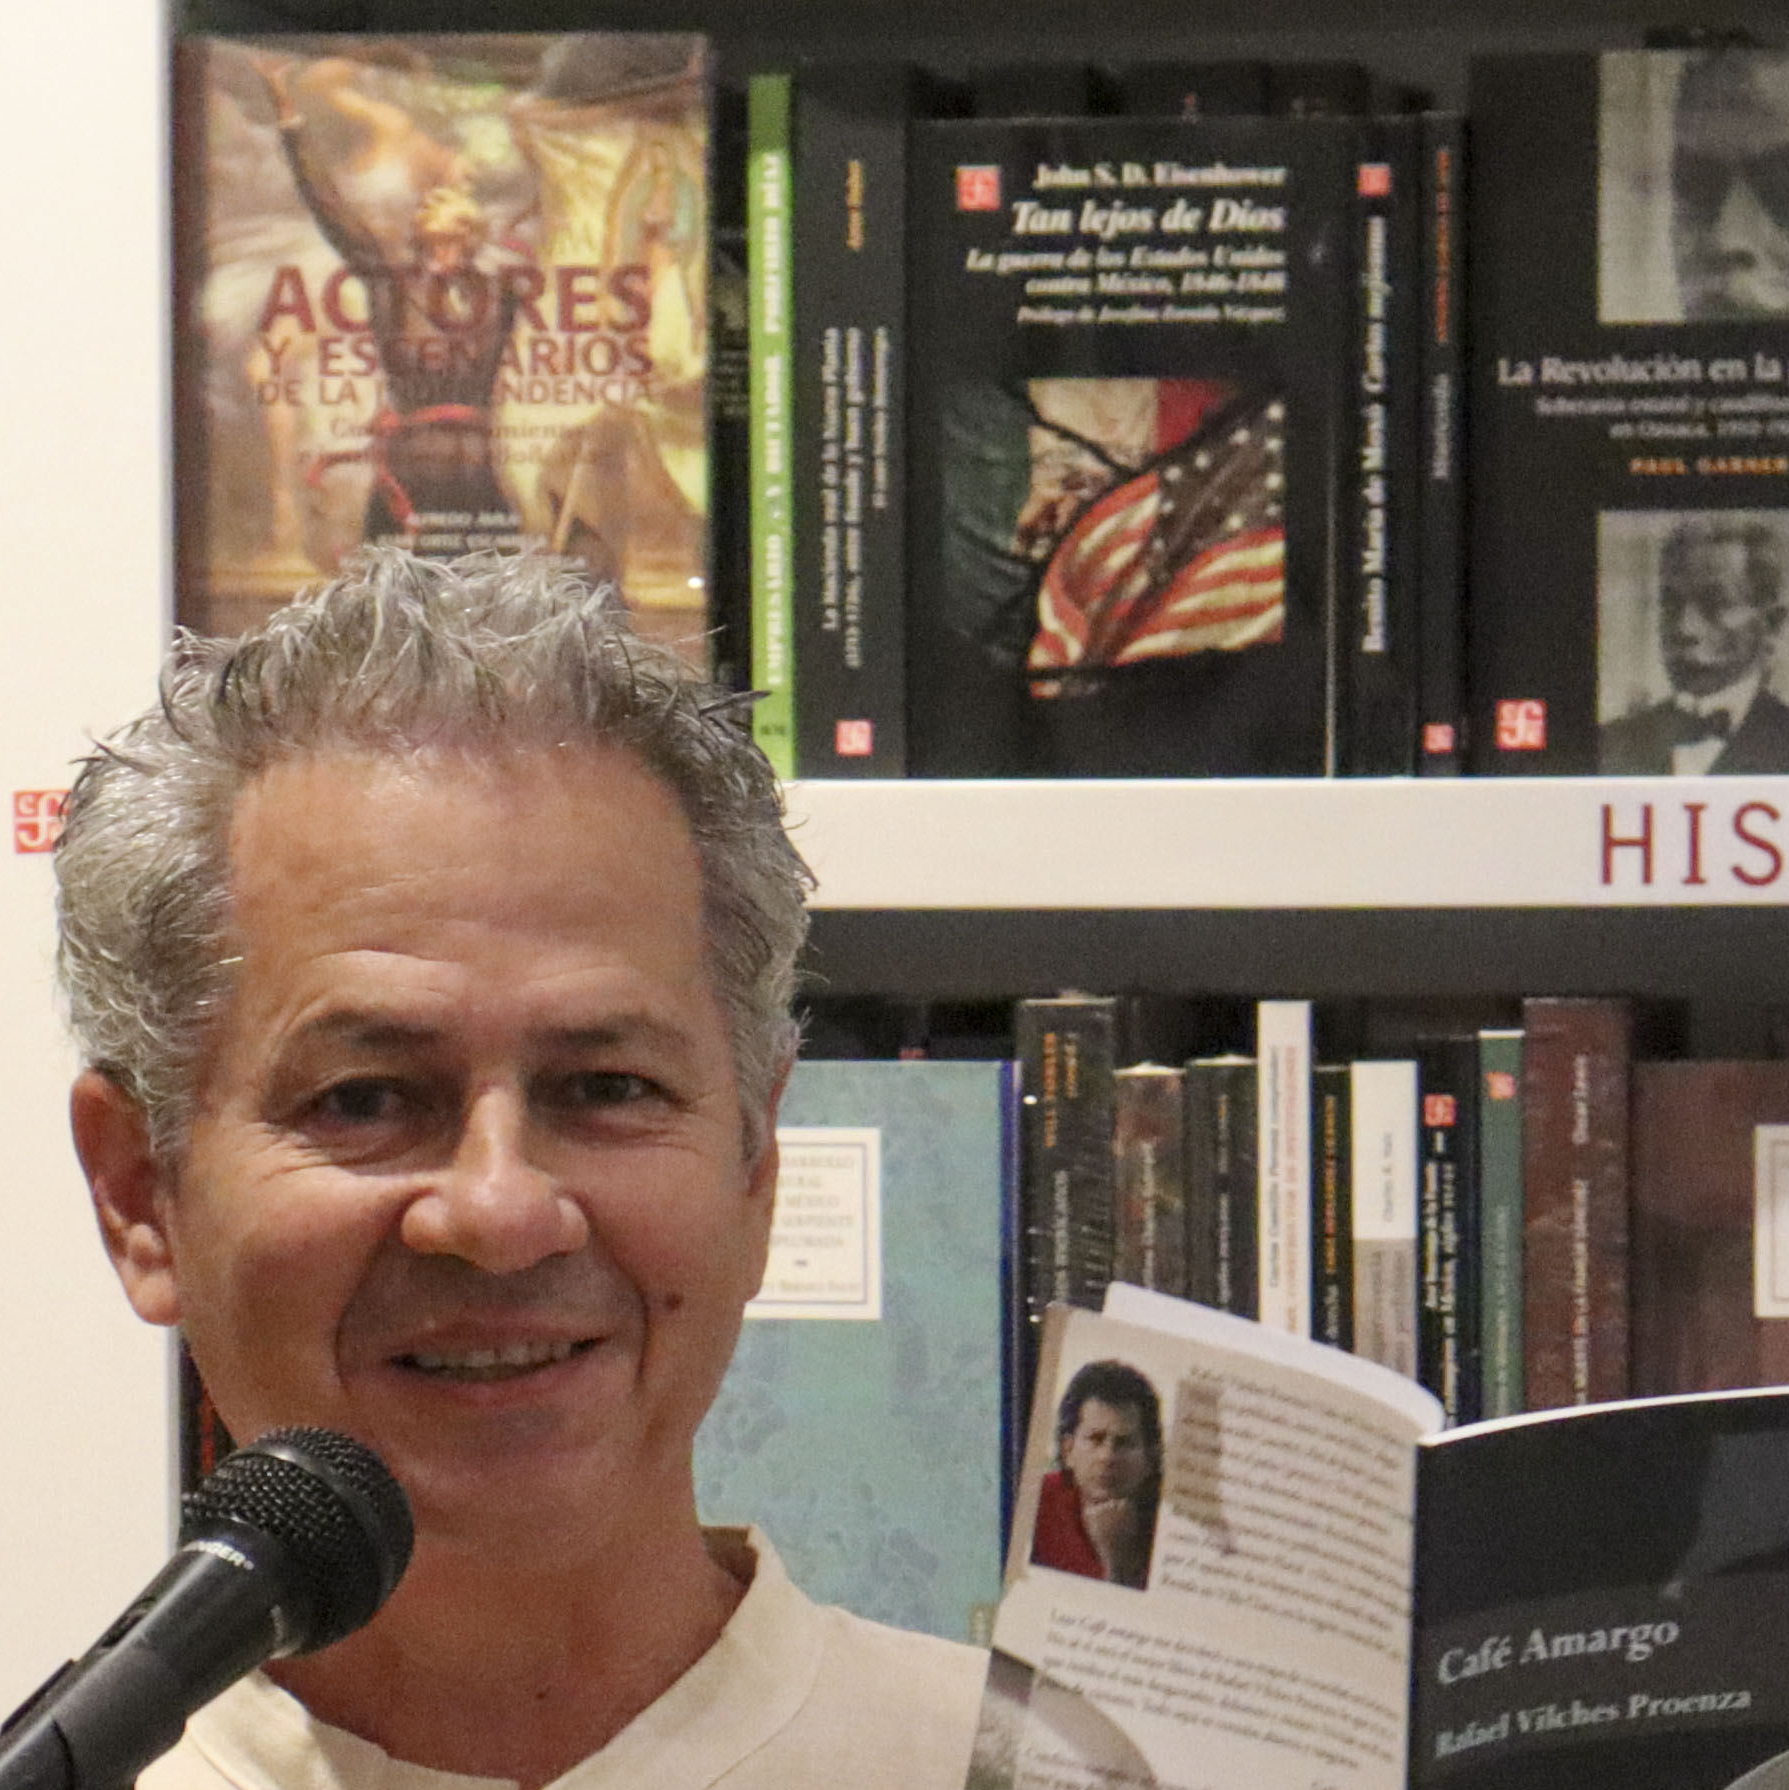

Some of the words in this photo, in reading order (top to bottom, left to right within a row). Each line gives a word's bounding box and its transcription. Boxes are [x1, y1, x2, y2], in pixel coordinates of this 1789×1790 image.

[1013, 199, 1073, 235] Tan
[1079, 199, 1155, 242] lejos
[1161, 198, 1203, 233] de
[1210, 198, 1286, 233] Dios
[261, 264, 653, 334] ACTORES
[261, 337, 291, 376] Y
[1497, 358, 1532, 385] La
[1707, 359, 1747, 382] en
[1754, 354, 1782, 383] la
[1437, 1637, 1513, 1685] Café
[1519, 1619, 1680, 1663] Amargo
[1628, 1687, 1752, 1720] Proenza
